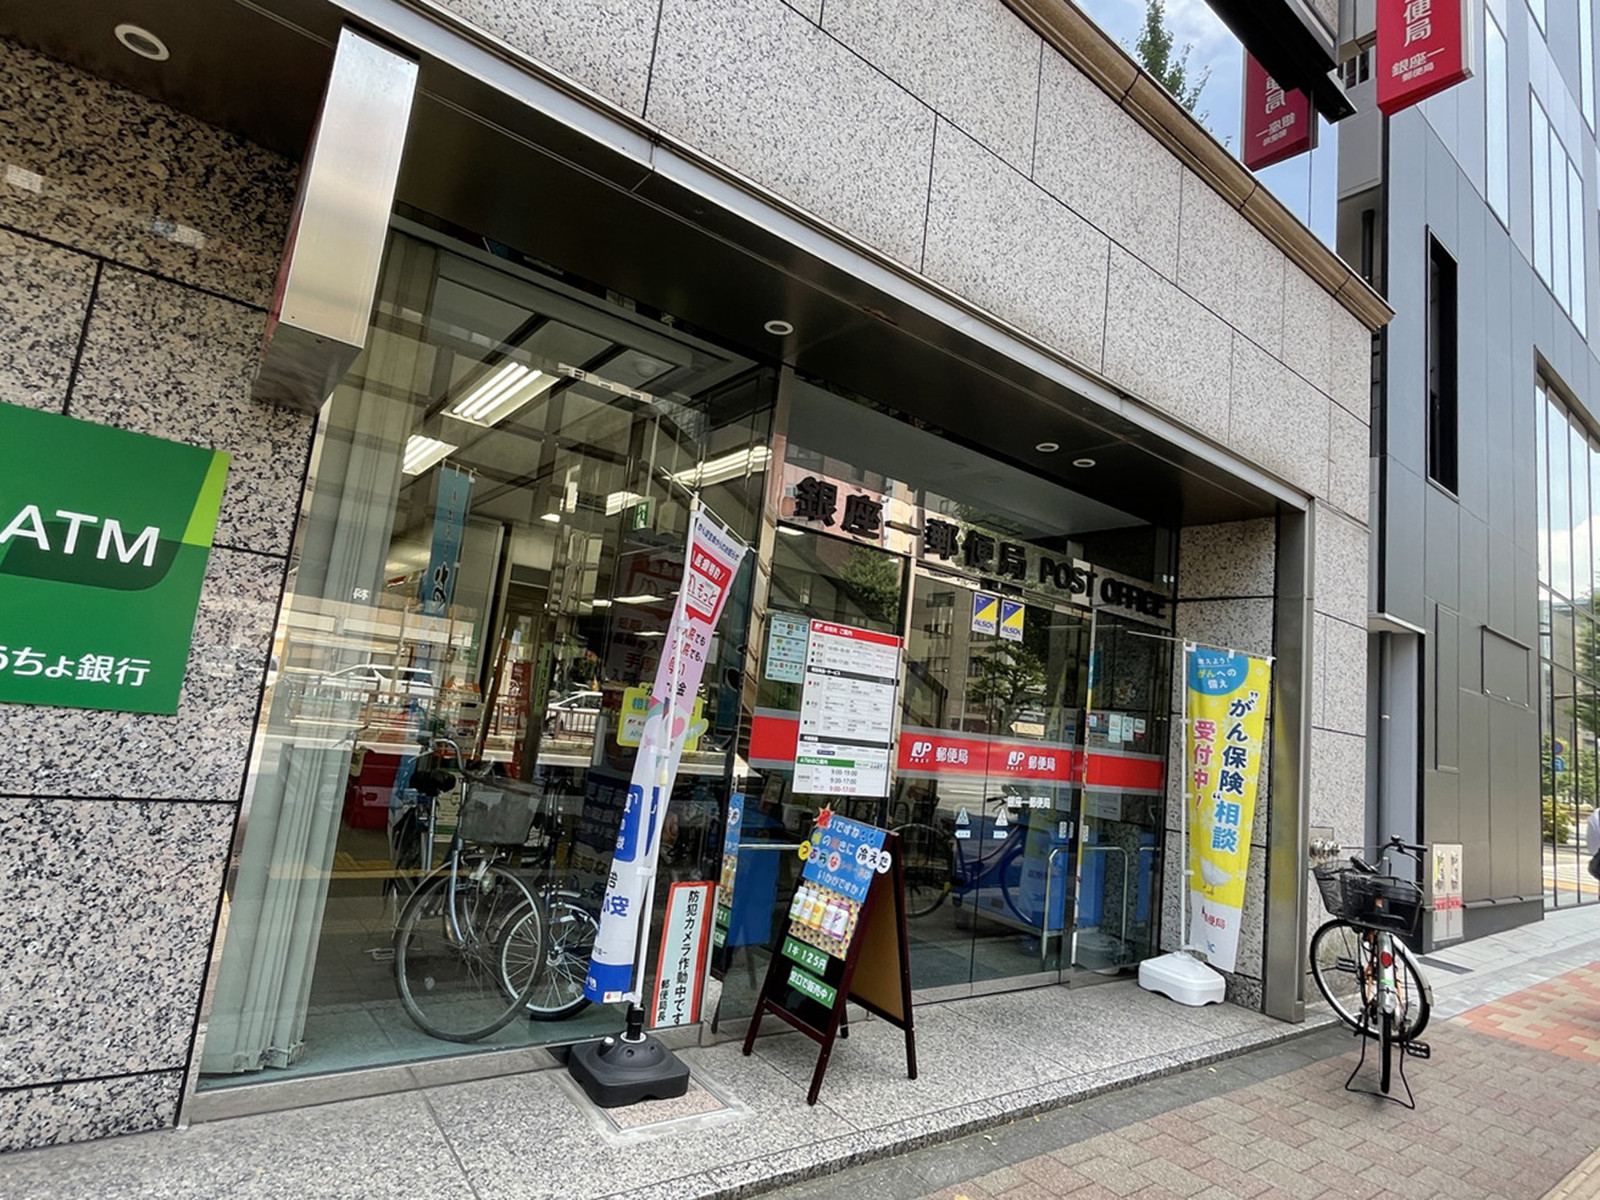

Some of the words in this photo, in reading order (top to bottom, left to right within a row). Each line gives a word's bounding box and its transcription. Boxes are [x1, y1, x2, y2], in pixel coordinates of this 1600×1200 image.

[1391, 47, 1445, 78] 銀座一
[0, 504, 160, 567] ATM
[793, 476, 1028, 581] 銀座一郵便局
[1037, 556, 1098, 596] POST
[1100, 577, 1167, 620] OFFICE
[935, 746, 968, 765] 郵便局
[1028, 756, 1056, 771] 郵便局
[671, 889, 701, 1027] 防犯カメラ作動中です
